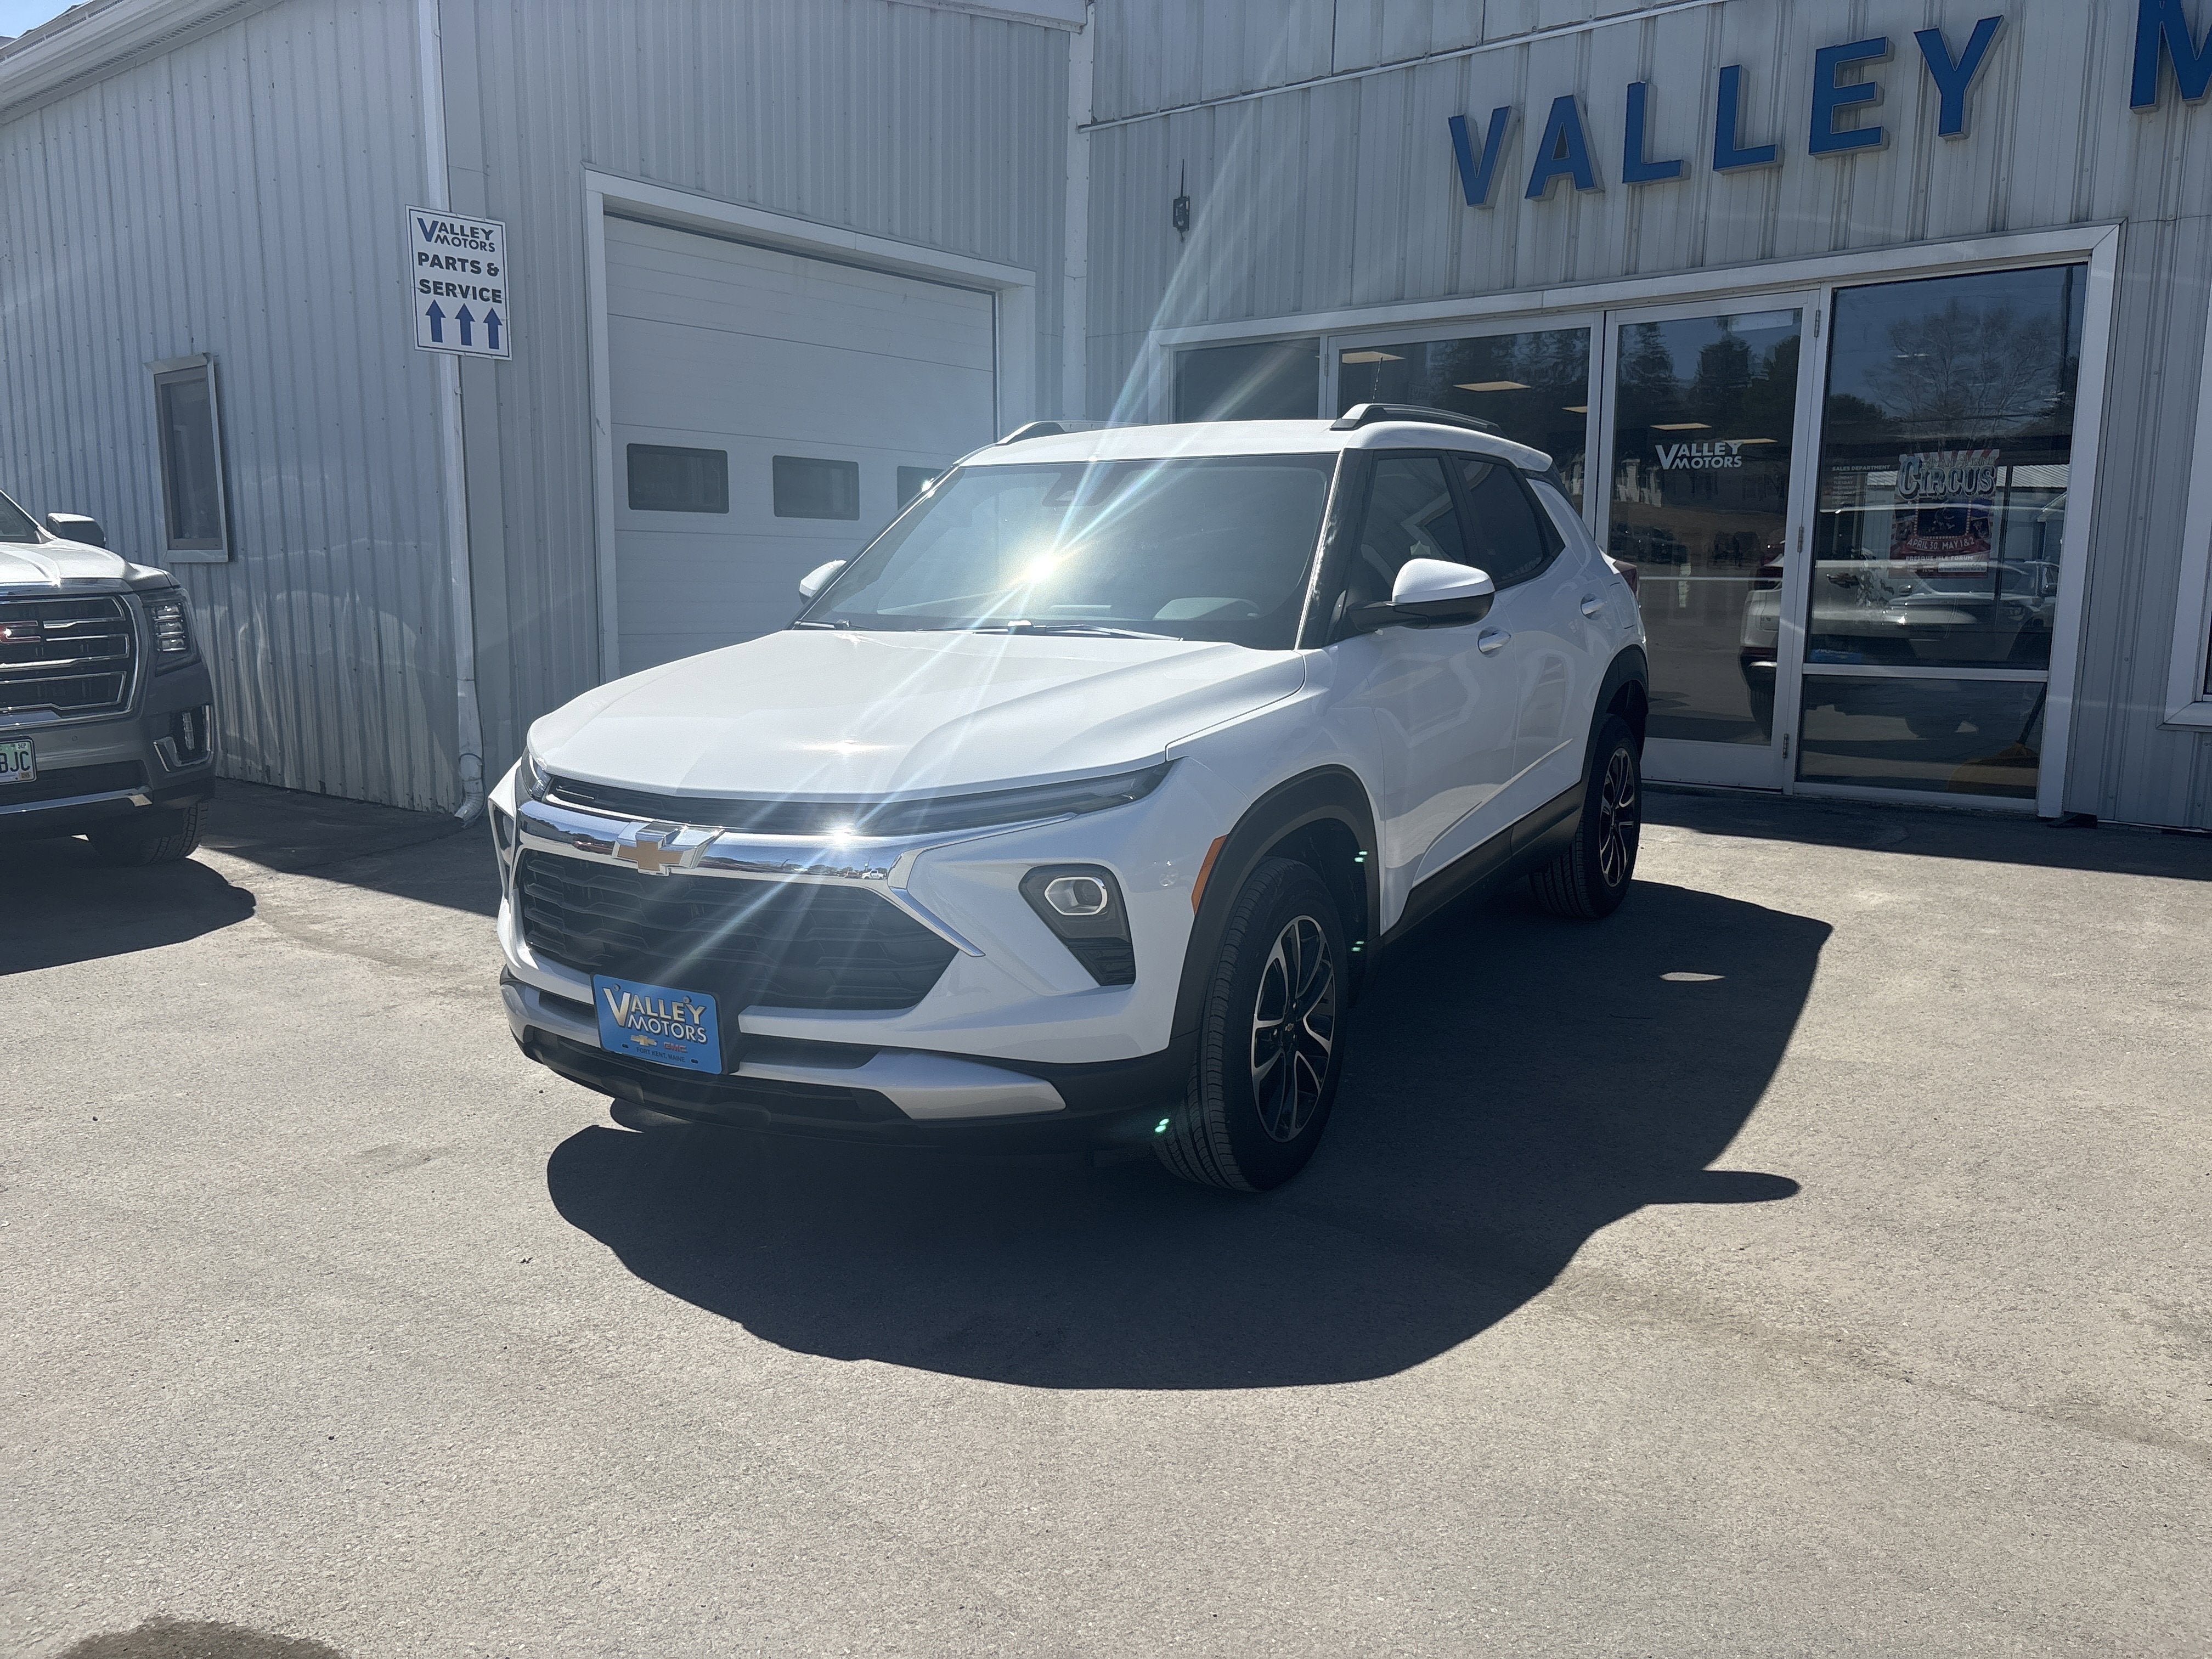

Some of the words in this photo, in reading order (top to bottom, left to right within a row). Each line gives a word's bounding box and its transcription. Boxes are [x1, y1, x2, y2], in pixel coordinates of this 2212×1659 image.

[1447, 15, 2006, 209] VALLEY
[417, 217, 494, 242] VALLEY
[434, 234, 495, 252] MOTORS
[417, 252, 482, 275] PARTS
[487, 262, 500, 276] &
[419, 279, 503, 304] SERVICE
[1655, 441, 1744, 470] VALLEY
[1672, 456, 1742, 470] MOTORS
[1898, 456, 1996, 500] CIRCUS
[1906, 539, 1928, 549] APRIL
[1942, 541, 1959, 550] MAY
[603, 988, 707, 1027] VALLEY
[627, 1014, 708, 1044] MOTORS
[652, 1050, 668, 1059] KENT,
[668, 1054, 686, 1063] MAINE
